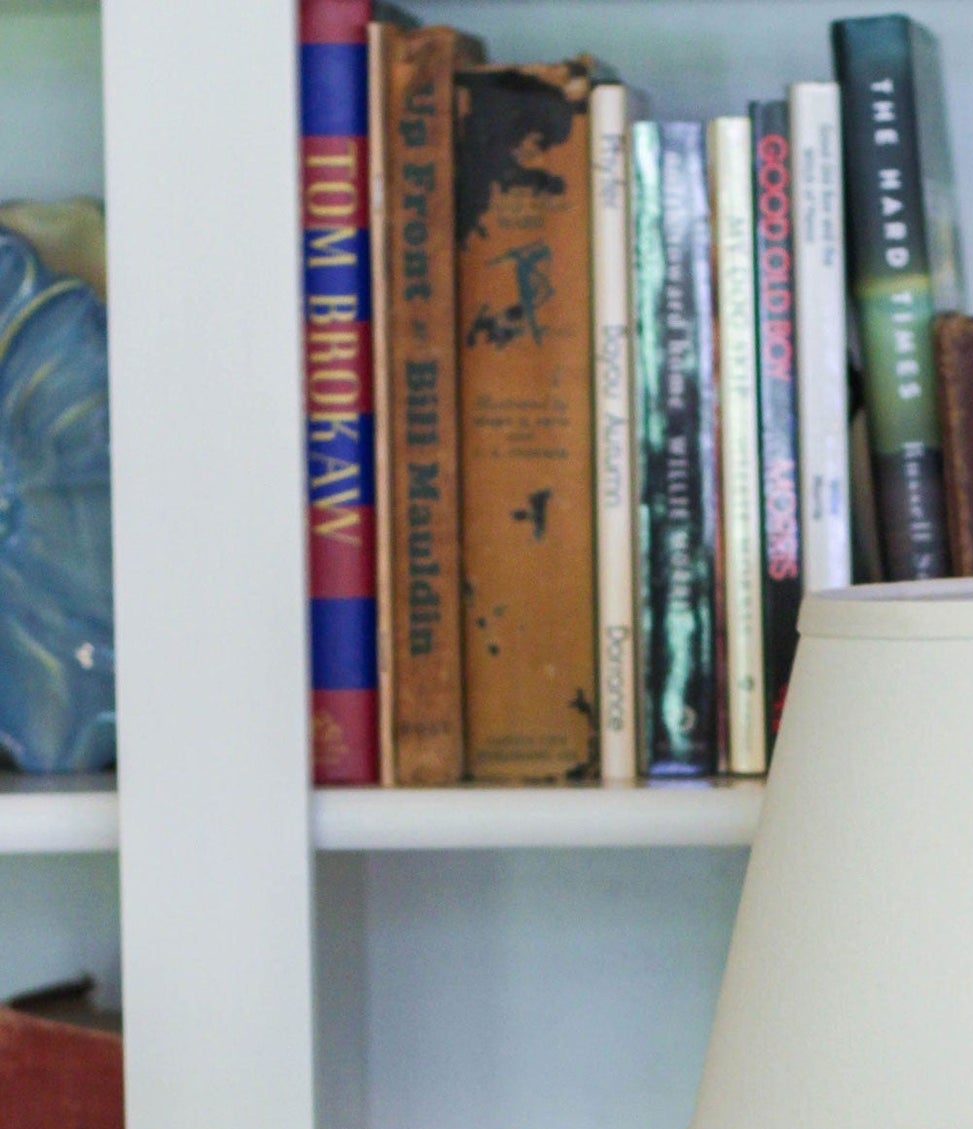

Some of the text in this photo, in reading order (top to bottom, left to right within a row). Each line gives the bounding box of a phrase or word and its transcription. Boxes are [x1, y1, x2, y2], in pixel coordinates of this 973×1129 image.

[397, 79, 437, 302] Up Front
[756, 133, 795, 384] GOOD OLD BOY
[870, 77, 923, 400] THE HARD TIMES
[306, 138, 361, 547] TOM BROKAW
[594, 324, 630, 509] Bayou Autumn
[405, 360, 442, 658] Bill Mauldin
[901, 440, 932, 542] Russell
[605, 625, 632, 732] Dorrance
